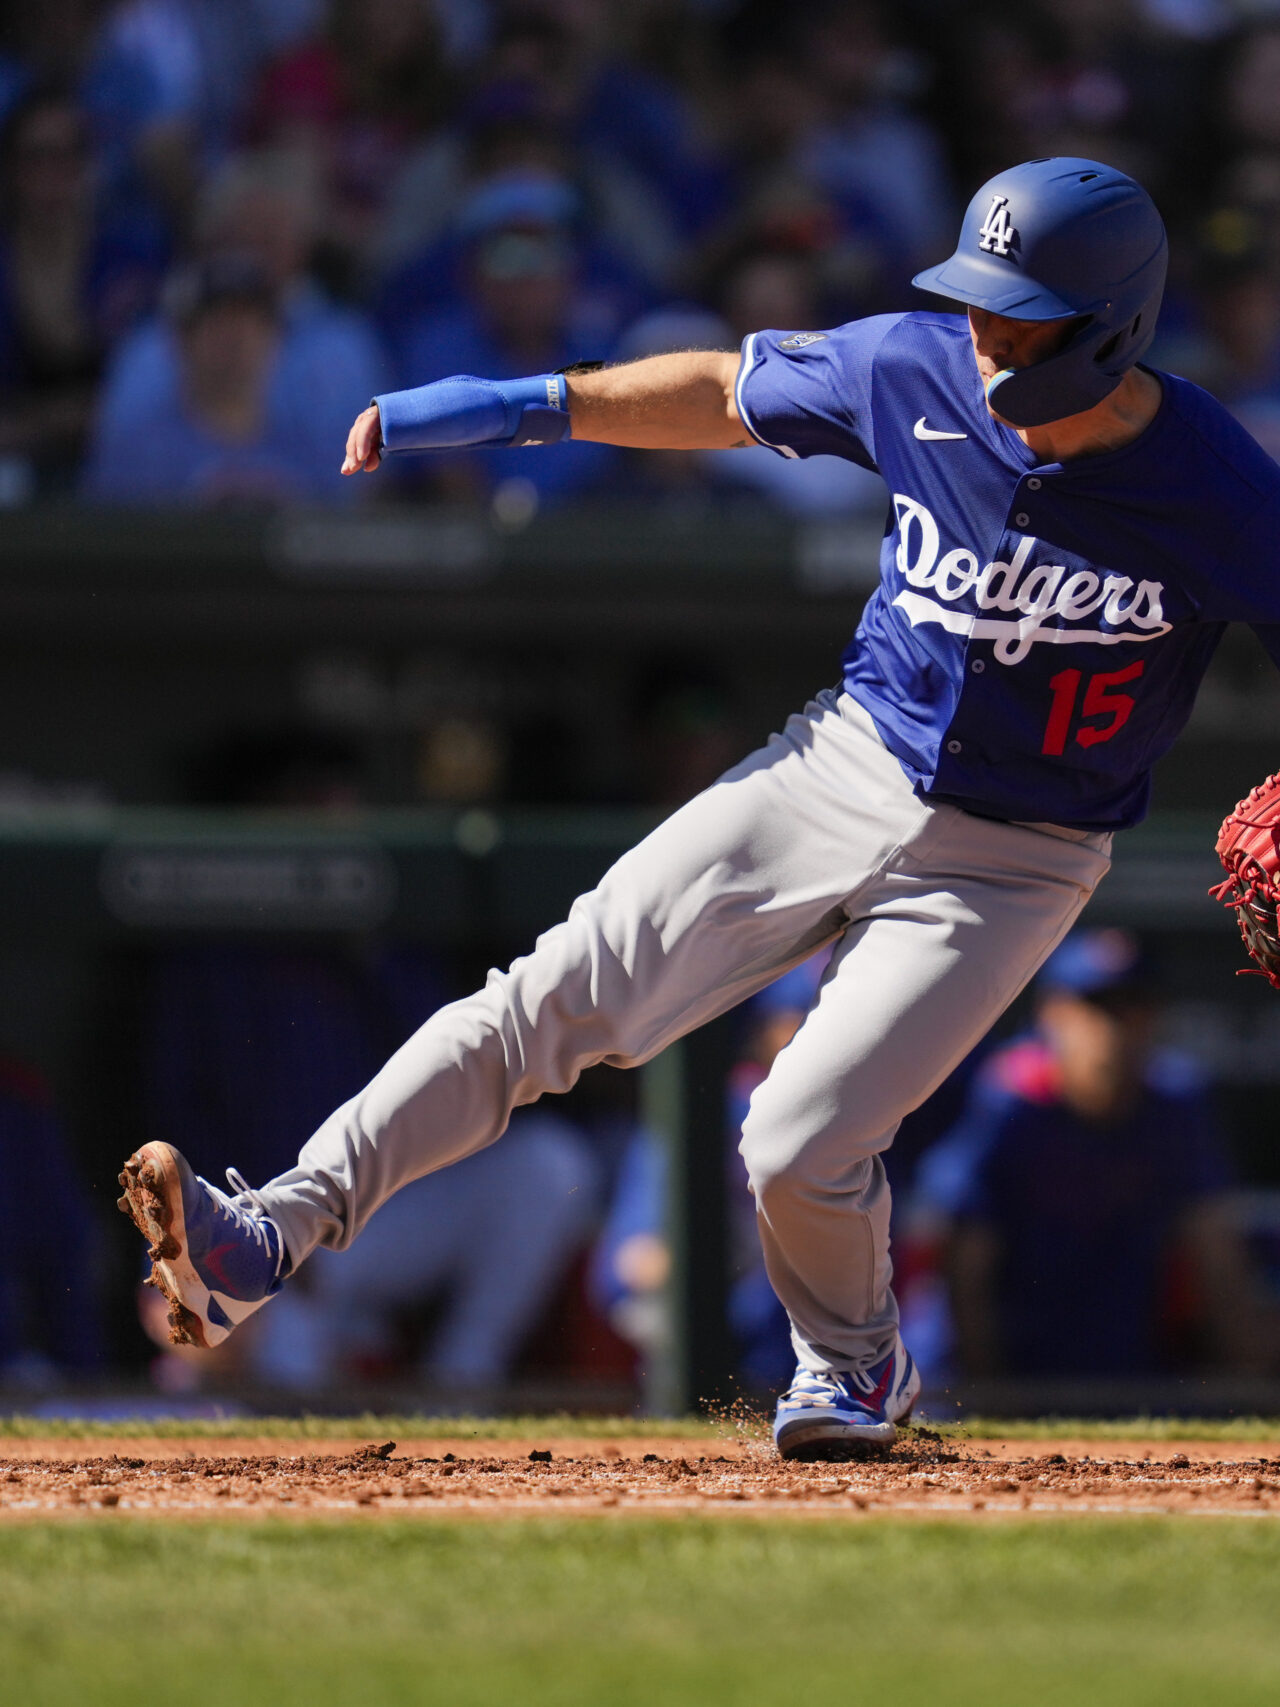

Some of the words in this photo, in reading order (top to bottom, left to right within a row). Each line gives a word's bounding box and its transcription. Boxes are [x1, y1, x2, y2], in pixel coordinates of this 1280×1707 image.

[978, 195, 1014, 256] LA
[892, 493, 1173, 666] Dodgers
[1040, 660, 1145, 756] 15
